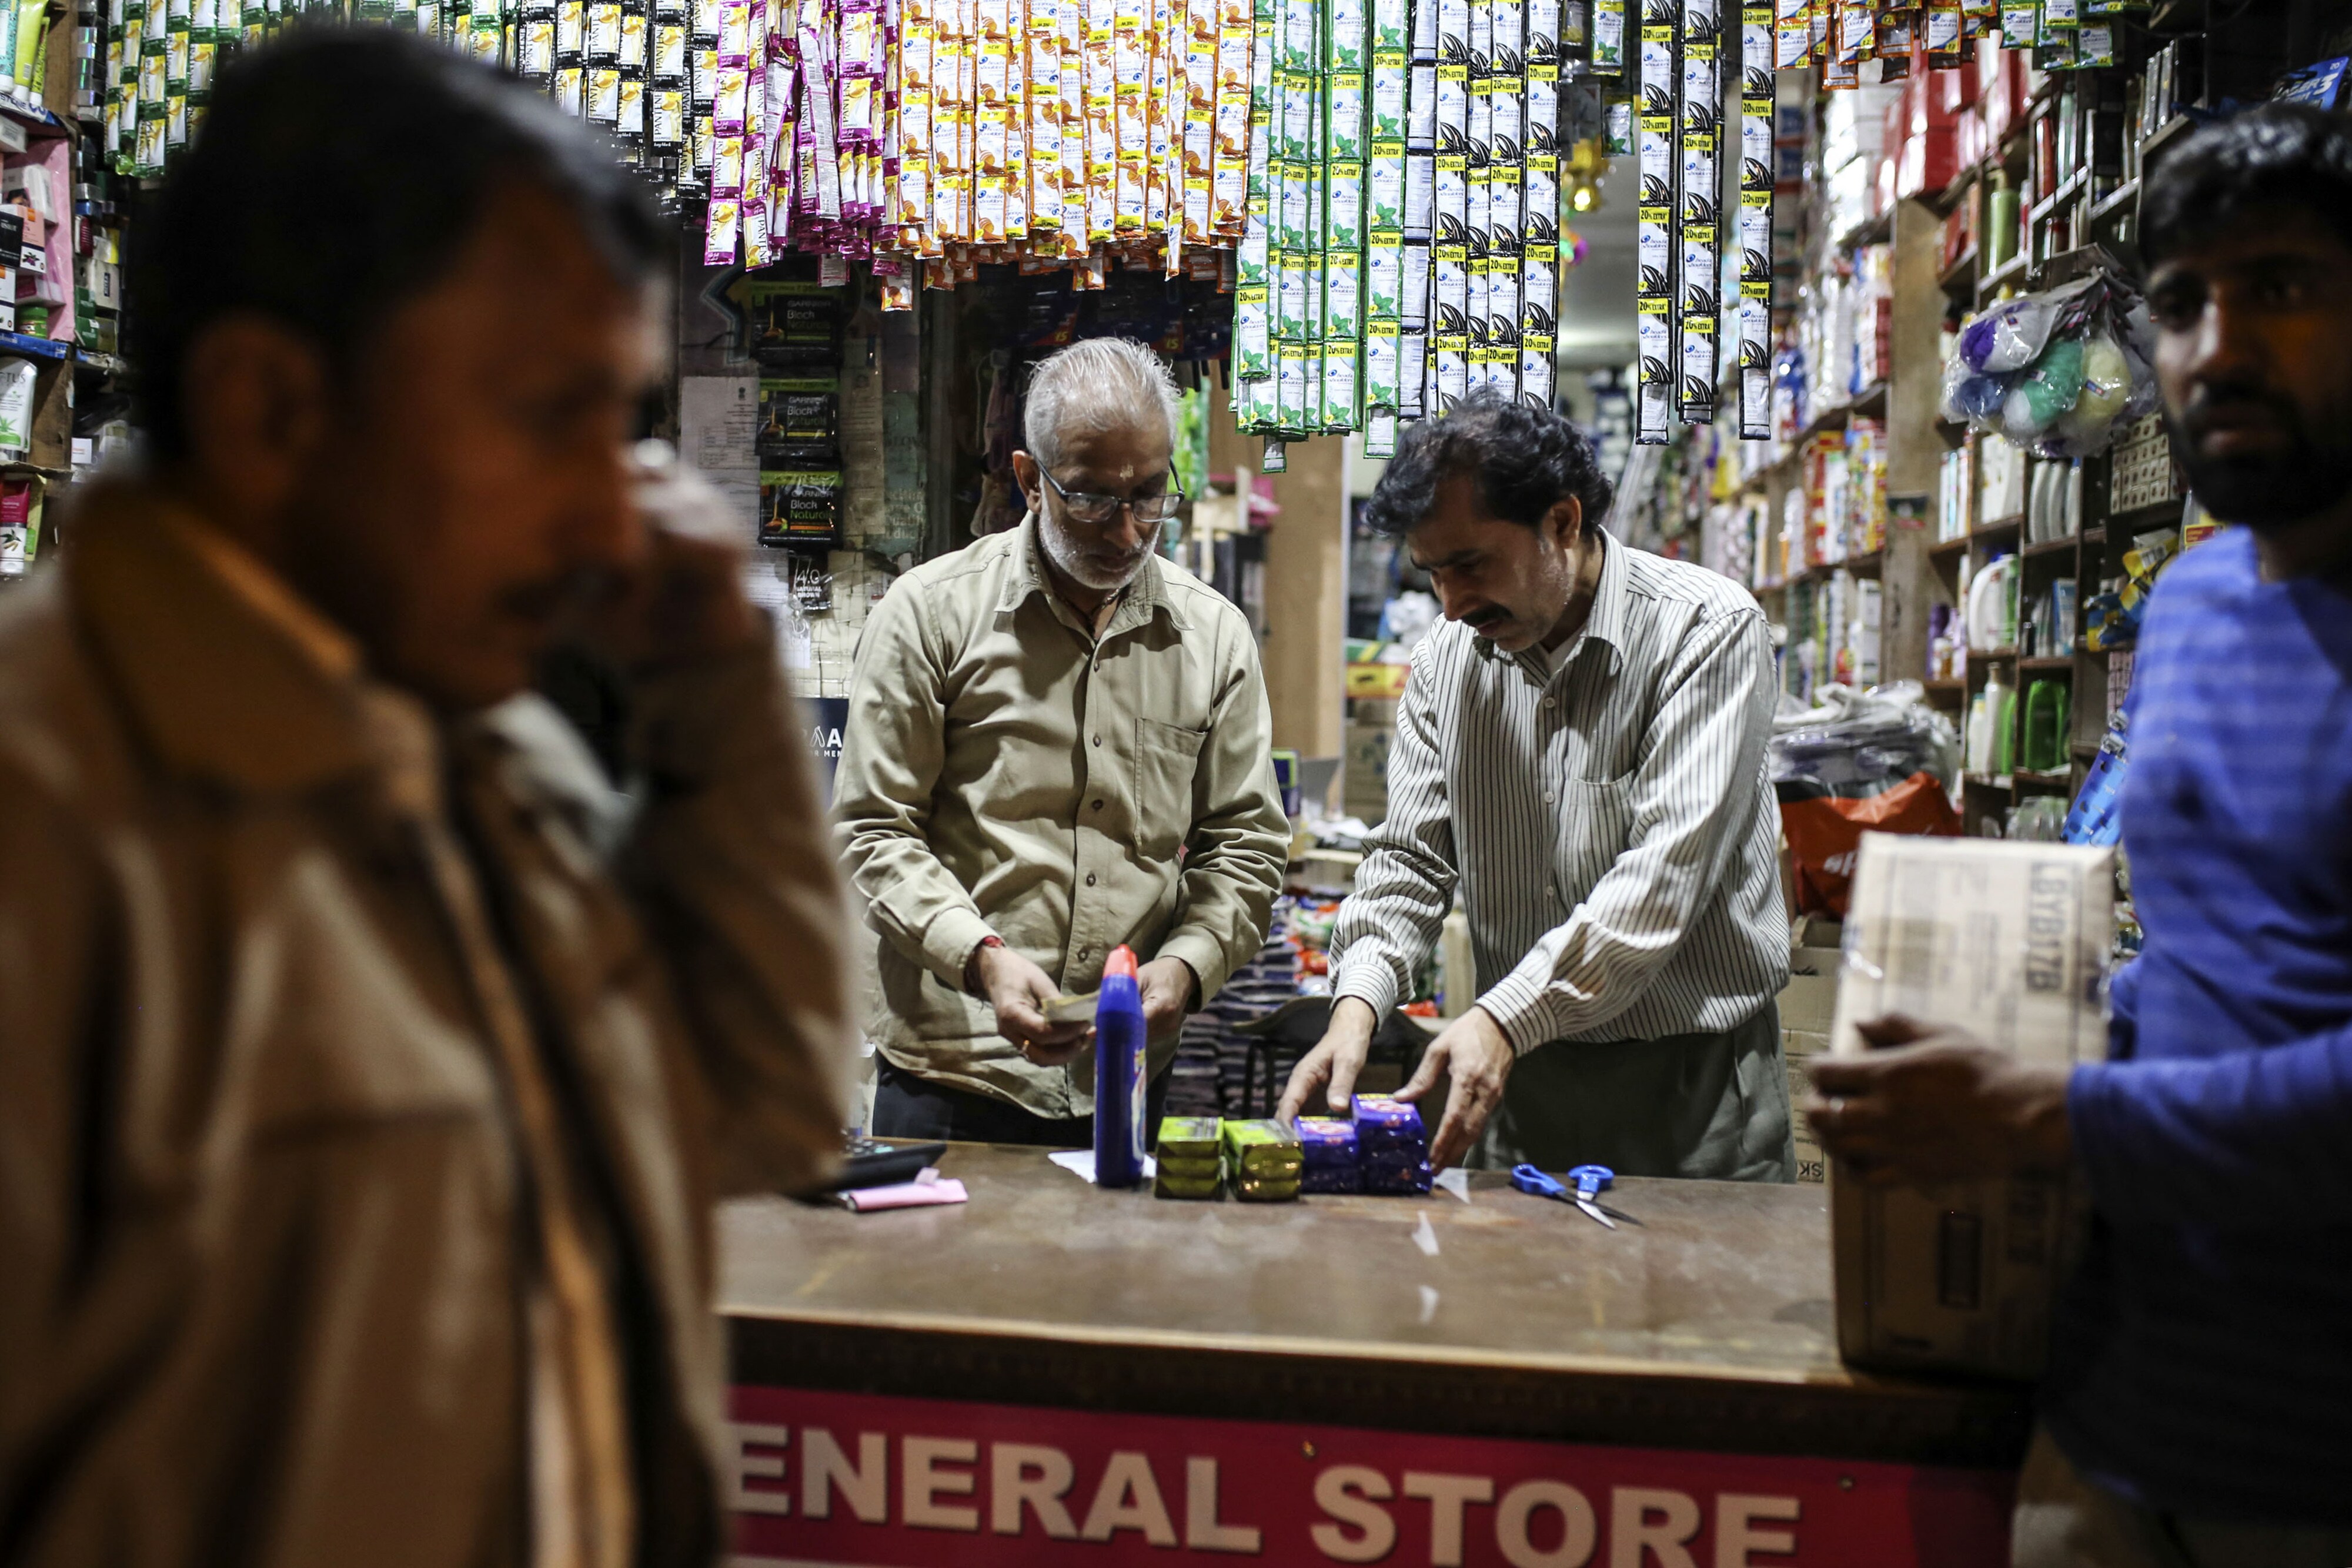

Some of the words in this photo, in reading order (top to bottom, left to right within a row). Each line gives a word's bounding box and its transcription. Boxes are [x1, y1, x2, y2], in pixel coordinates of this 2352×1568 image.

[721, 10, 730, 50] PANTENE
[656, 26, 664, 69] PANTENE
[589, 68, 599, 111] PANTENE
[843, 79, 851, 123] PANTENE
[1743, 103, 1755, 112] 20%
[654, 92, 662, 135] PANTENE
[1642, 120, 1654, 129] 20%
[680, 134, 688, 178] PANTENE
[715, 141, 723, 180] PANTENE
[754, 149, 763, 196] PANTENE
[1742, 194, 1754, 203] 20%
[1641, 210, 1652, 219] 20%
[1686, 229, 1698, 238] 20%
[758, 219, 768, 263] PANTENE
[1372, 235, 1384, 244] 20%
[1438, 249, 1449, 258] 20%
[1527, 248, 1538, 257] 20%
[1491, 260, 1502, 269] 20%
[1741, 285, 1753, 294] 20%
[1639, 302, 1651, 311] 20%
[1369, 325, 1381, 333] 20%
[1525, 338, 1536, 347] 20%
[1489, 350, 1500, 359] 20%
[790, 500, 817, 509] Black
[730, 1420, 1262, 1553] ENERAL
[1311, 1464, 1800, 1568] STORE
